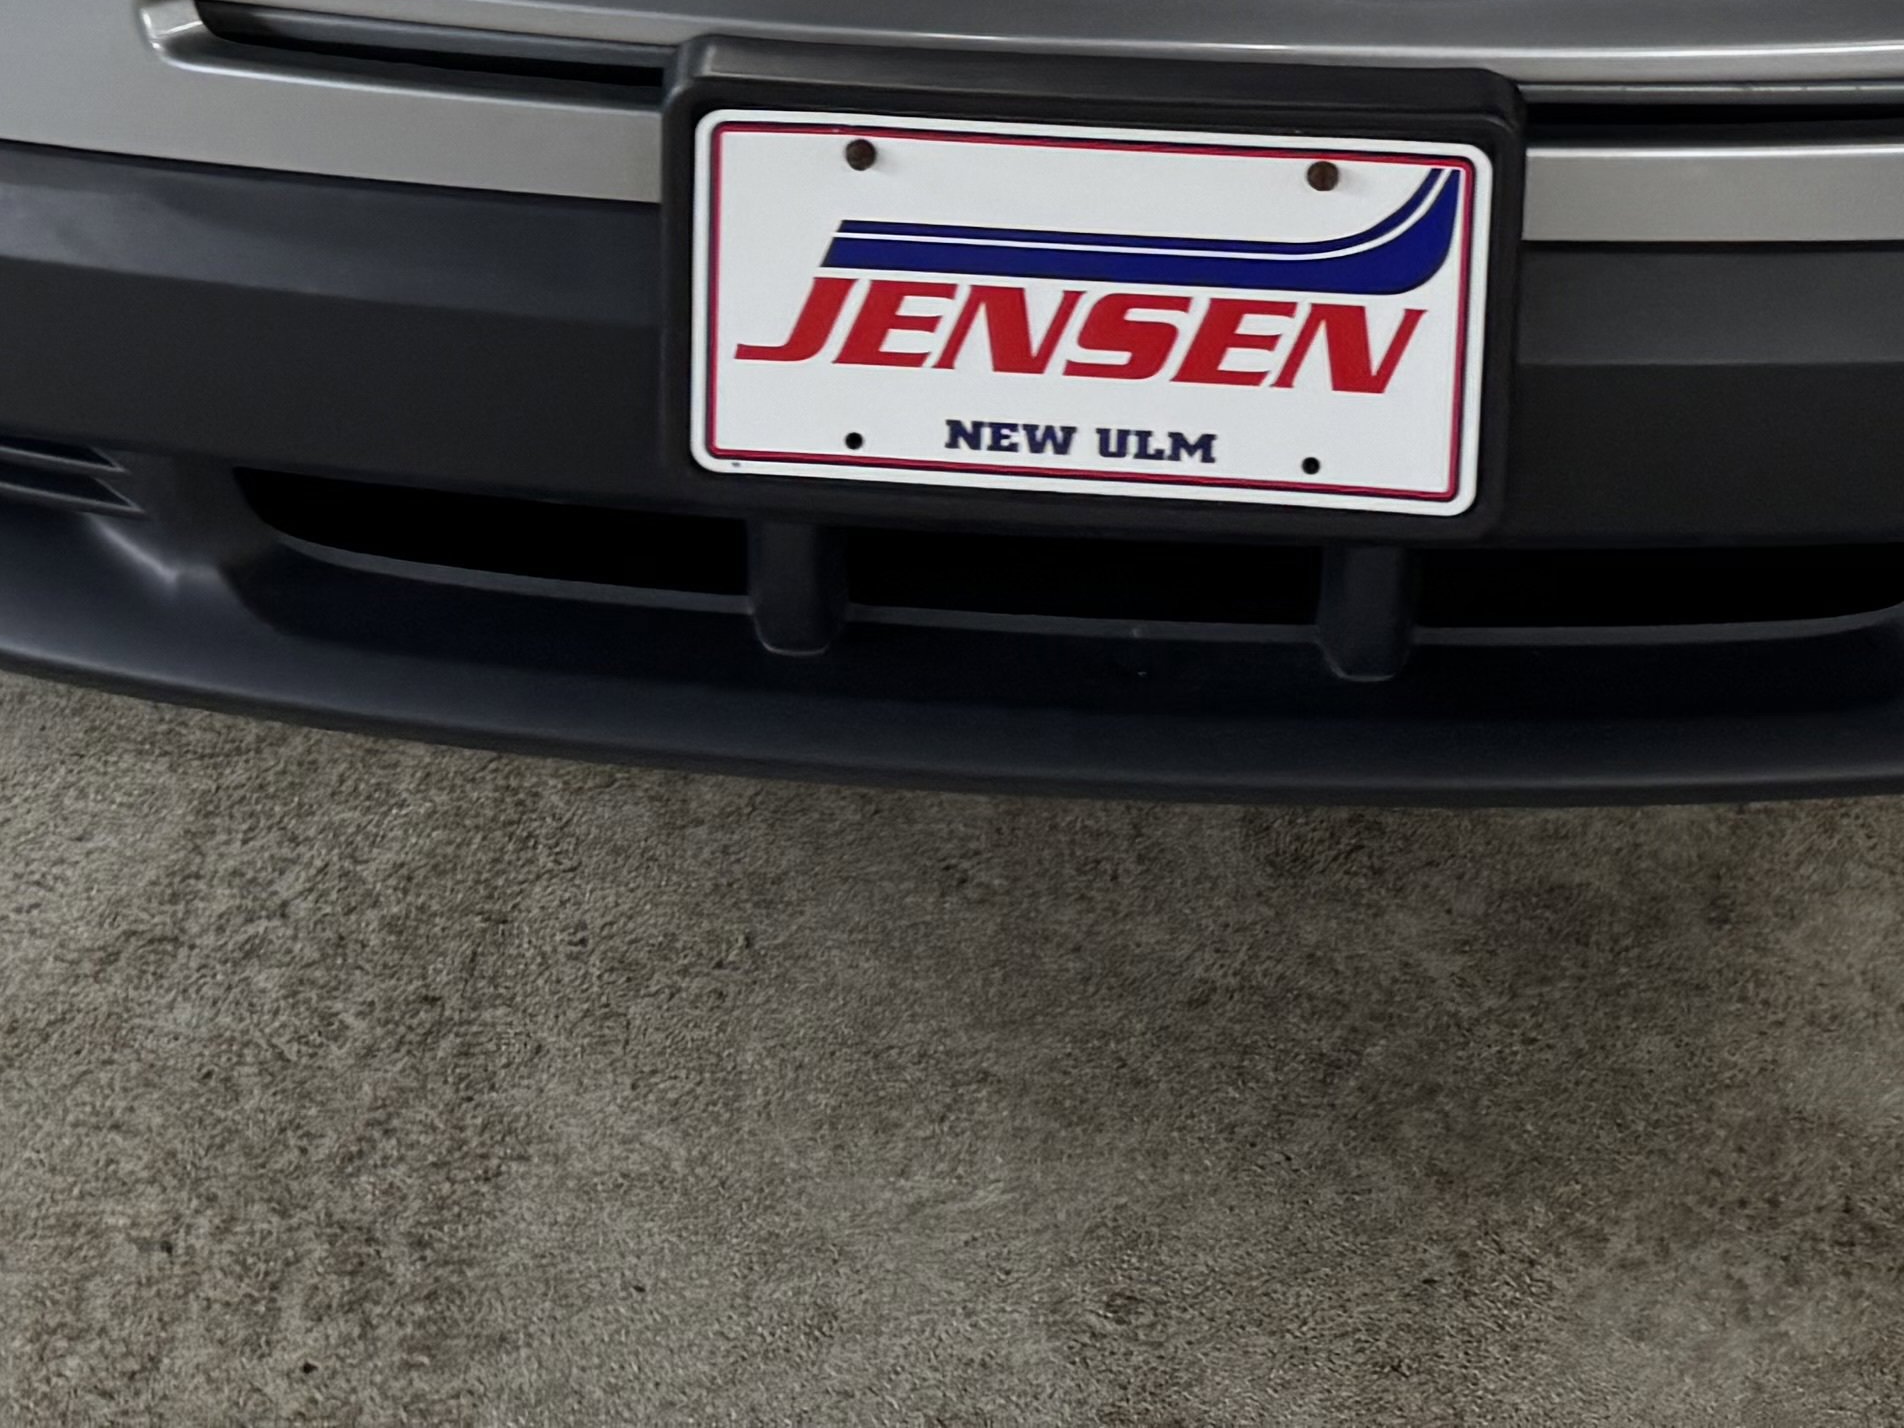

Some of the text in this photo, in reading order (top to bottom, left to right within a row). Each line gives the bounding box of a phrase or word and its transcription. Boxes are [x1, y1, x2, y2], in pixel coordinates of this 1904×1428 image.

[734, 275, 1428, 394] JENSEN
[943, 418, 1217, 464] NEW ULM
